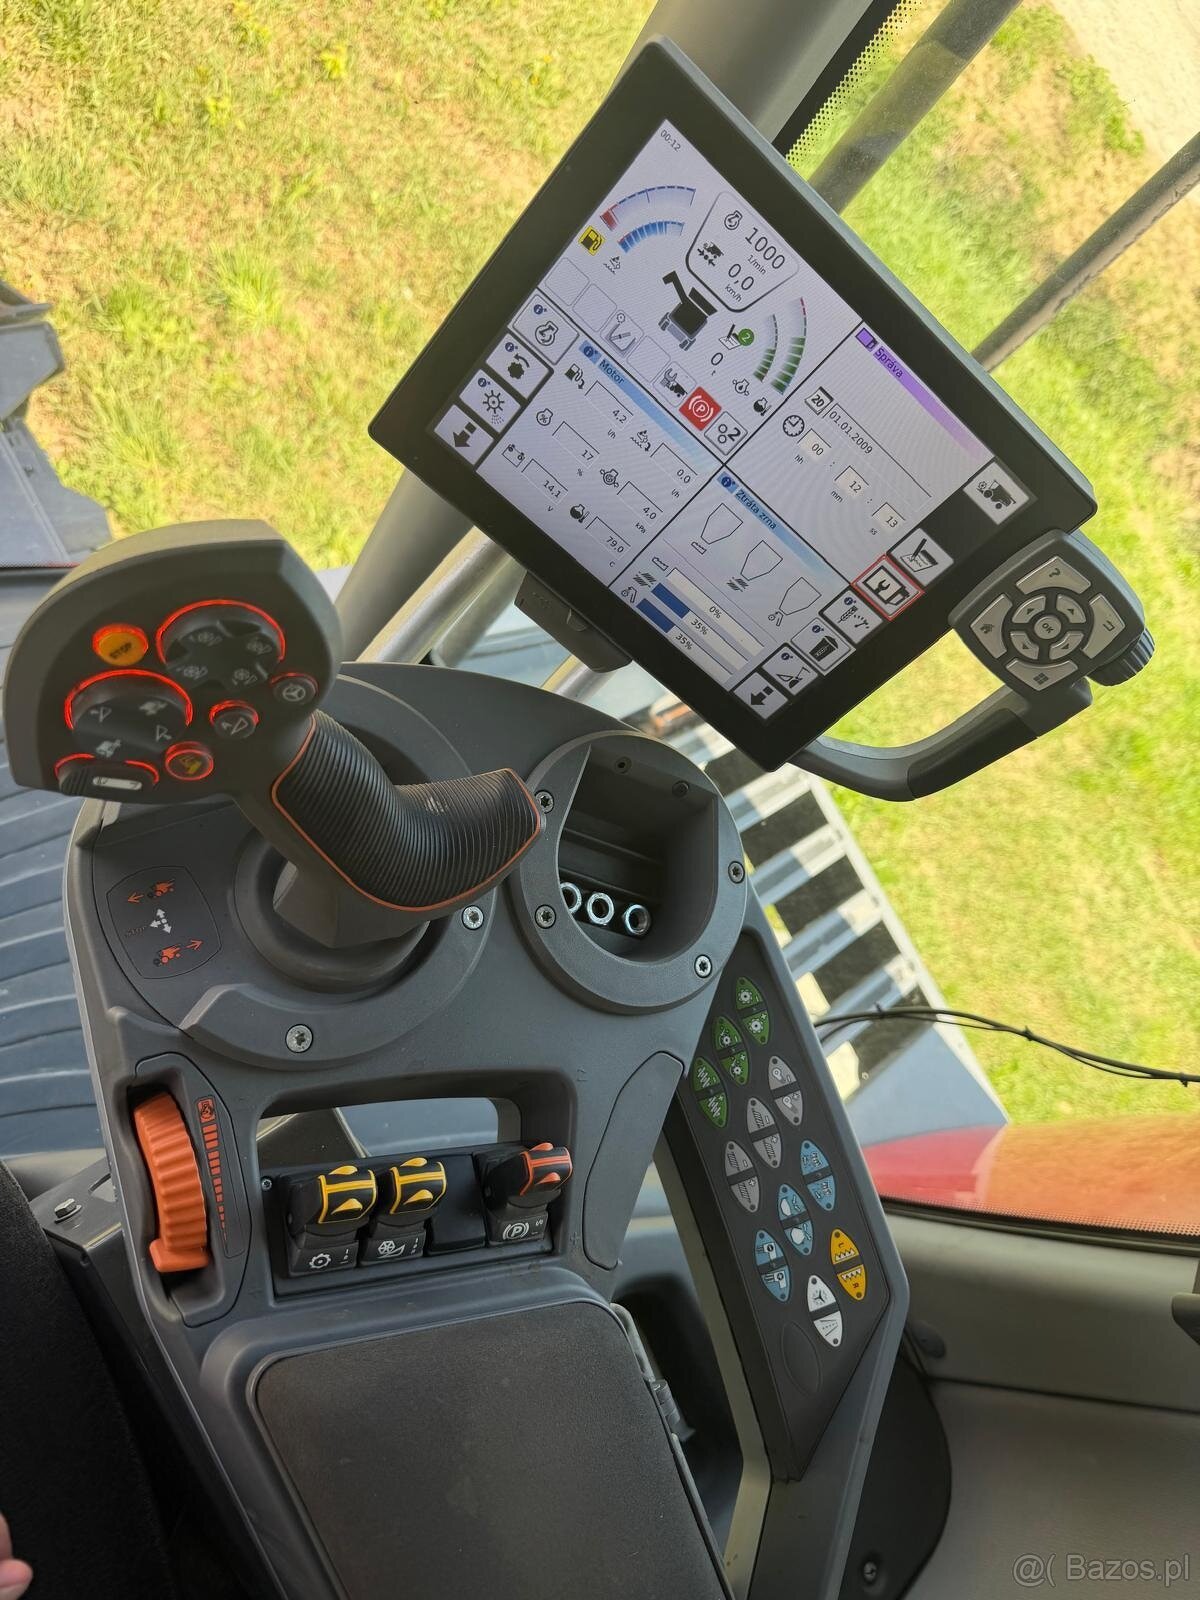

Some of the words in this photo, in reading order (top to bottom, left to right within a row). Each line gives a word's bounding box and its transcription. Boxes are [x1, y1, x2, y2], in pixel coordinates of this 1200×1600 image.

[660, 129, 681, 152] 00:12
[745, 227, 786, 270] 1000
[747, 255, 766, 275] 1/min
[728, 263, 755, 291] 0,0
[725, 284, 742, 302] km/h
[741, 332, 751, 342] 2
[710, 352, 724, 366] 0
[875, 347, 904, 379] Správa
[599, 360, 625, 384] Motor
[811, 394, 825, 408] 20
[727, 427, 742, 443] 2
[828, 411, 873, 454] 01.01.2009
[581, 449, 594, 461] 17
[543, 480, 561, 498] 14,1
[811, 443, 824, 456] 00
[849, 480, 862, 494] 12
[885, 516, 898, 528] 13
[831, 490, 843, 503] mm
[735, 489, 760, 514] Ztráta
[759, 510, 778, 531] zrna
[635, 522, 647, 534] kPa
[606, 536, 624, 553] 79,0
[709, 605, 721, 619] 0%
[690, 618, 709, 636] 35%
[1041, 622, 1055, 634] OK
[675, 634, 693, 651] 35%
[511, 1226, 522, 1237] P
